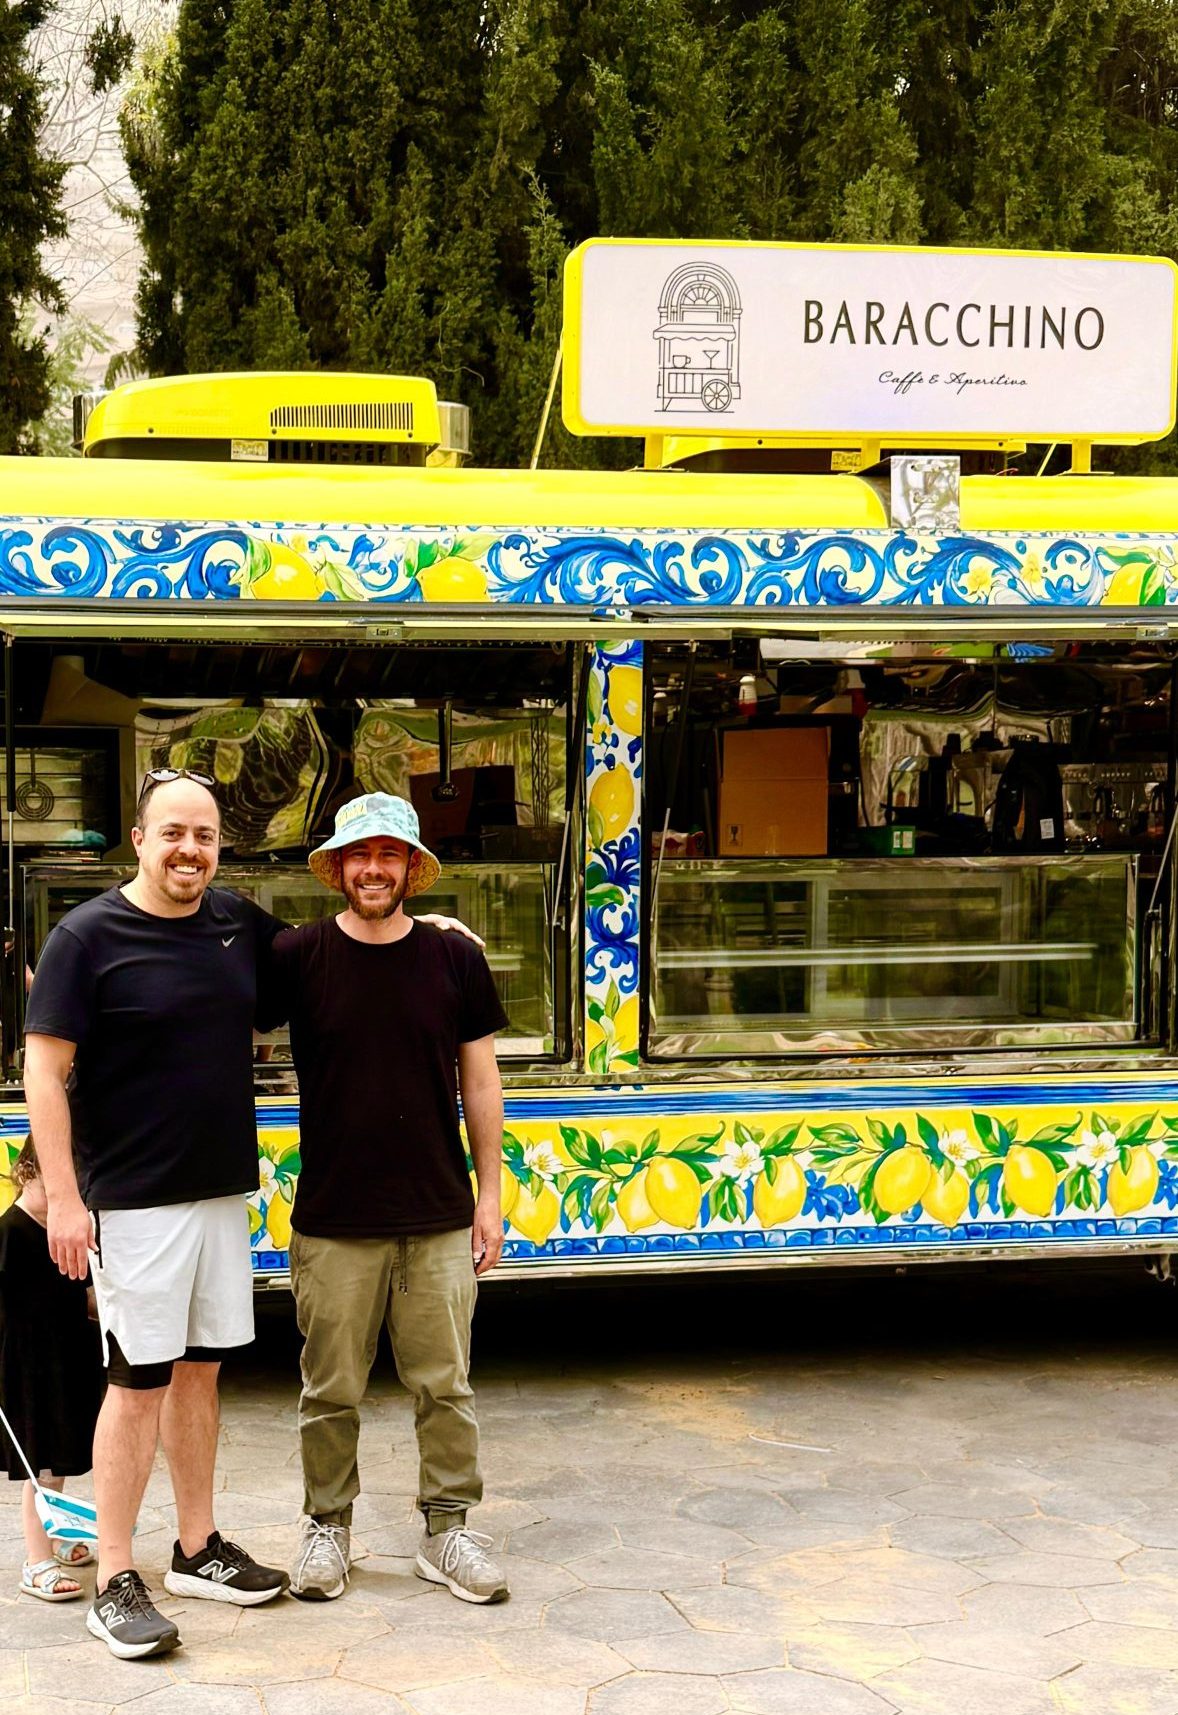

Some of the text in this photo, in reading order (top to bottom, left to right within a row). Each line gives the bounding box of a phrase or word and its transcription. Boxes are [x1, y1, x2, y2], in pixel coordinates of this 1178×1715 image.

[803, 299, 1105, 351] BARACCHINO
[928, 373, 940, 385] &
[943, 371, 1028, 396] Aperitivo
[197, 1559, 239, 1584] N
[99, 1601, 126, 1631] N
